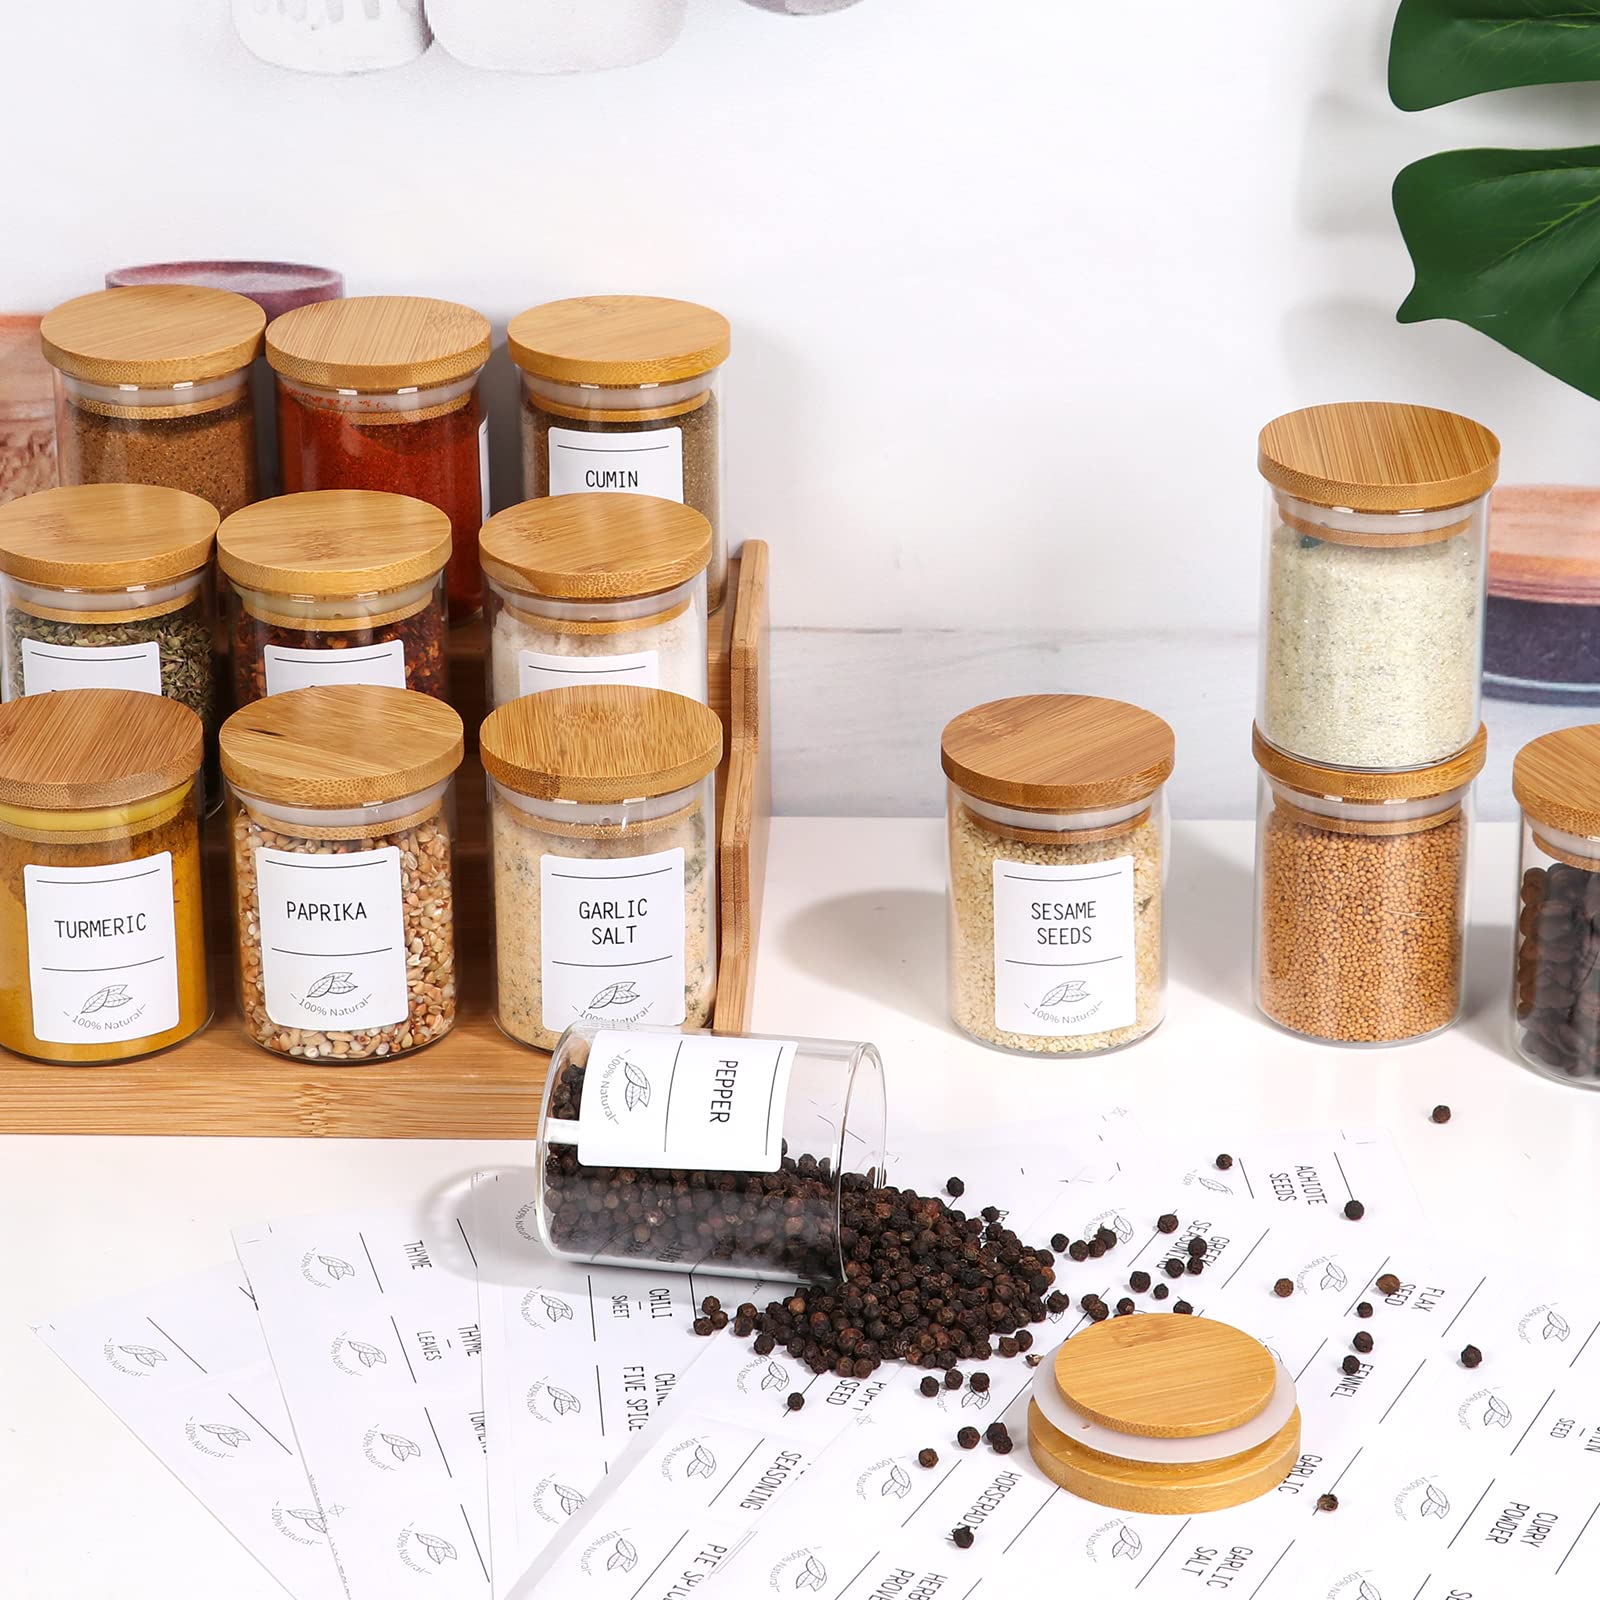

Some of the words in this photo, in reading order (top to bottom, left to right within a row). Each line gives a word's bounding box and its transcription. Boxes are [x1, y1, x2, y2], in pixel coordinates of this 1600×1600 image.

[585, 470, 638, 489] CUMIN
[286, 900, 367, 922] PAPRIKA
[578, 898, 648, 919] GARLIC
[1031, 900, 1097, 921] SESAME
[54, 912, 147, 938] TURMERIC
[592, 925, 637, 945] SALT
[1037, 926, 1092, 945] SEEDS
[72, 1015, 102, 1030] 100%
[104, 1009, 143, 1031] Natural
[298, 998, 327, 1016] 100%
[329, 998, 369, 1017] Natural
[1031, 1007, 1060, 1024] 100%
[1062, 1004, 1099, 1024] Natural
[602, 1054, 625, 1080] 100%
[599, 1080, 617, 1122] Natural
[708, 1059, 739, 1124] PEPPER
[1269, 1172, 1297, 1202] SEEDS
[1294, 1164, 1328, 1206] ACHIOTE
[402, 1239, 433, 1271] THYME
[611, 1295, 630, 1319] SWEET
[649, 1288, 673, 1319] CHILI
[1411, 1286, 1445, 1313] FLAX
[416, 1330, 442, 1362] LEAVES
[458, 1324, 482, 1357] THYME
[623, 1366, 646, 1392] FIVE
[654, 1373, 676, 1406] CHIN
[825, 1379, 861, 1406] SEED
[626, 1398, 649, 1432] SPICE
[1550, 1418, 1575, 1439] SEED
[739, 1450, 803, 1511] SEASONING
[944, 1470, 1022, 1541] HORSERADI
[1485, 1501, 1530, 1545] POWDER
[1520, 1512, 1558, 1548] CURRY
[693, 1543, 728, 1568] PIE
[1181, 1546, 1218, 1577] SALT
[1206, 1546, 1253, 1589] GARLIC
